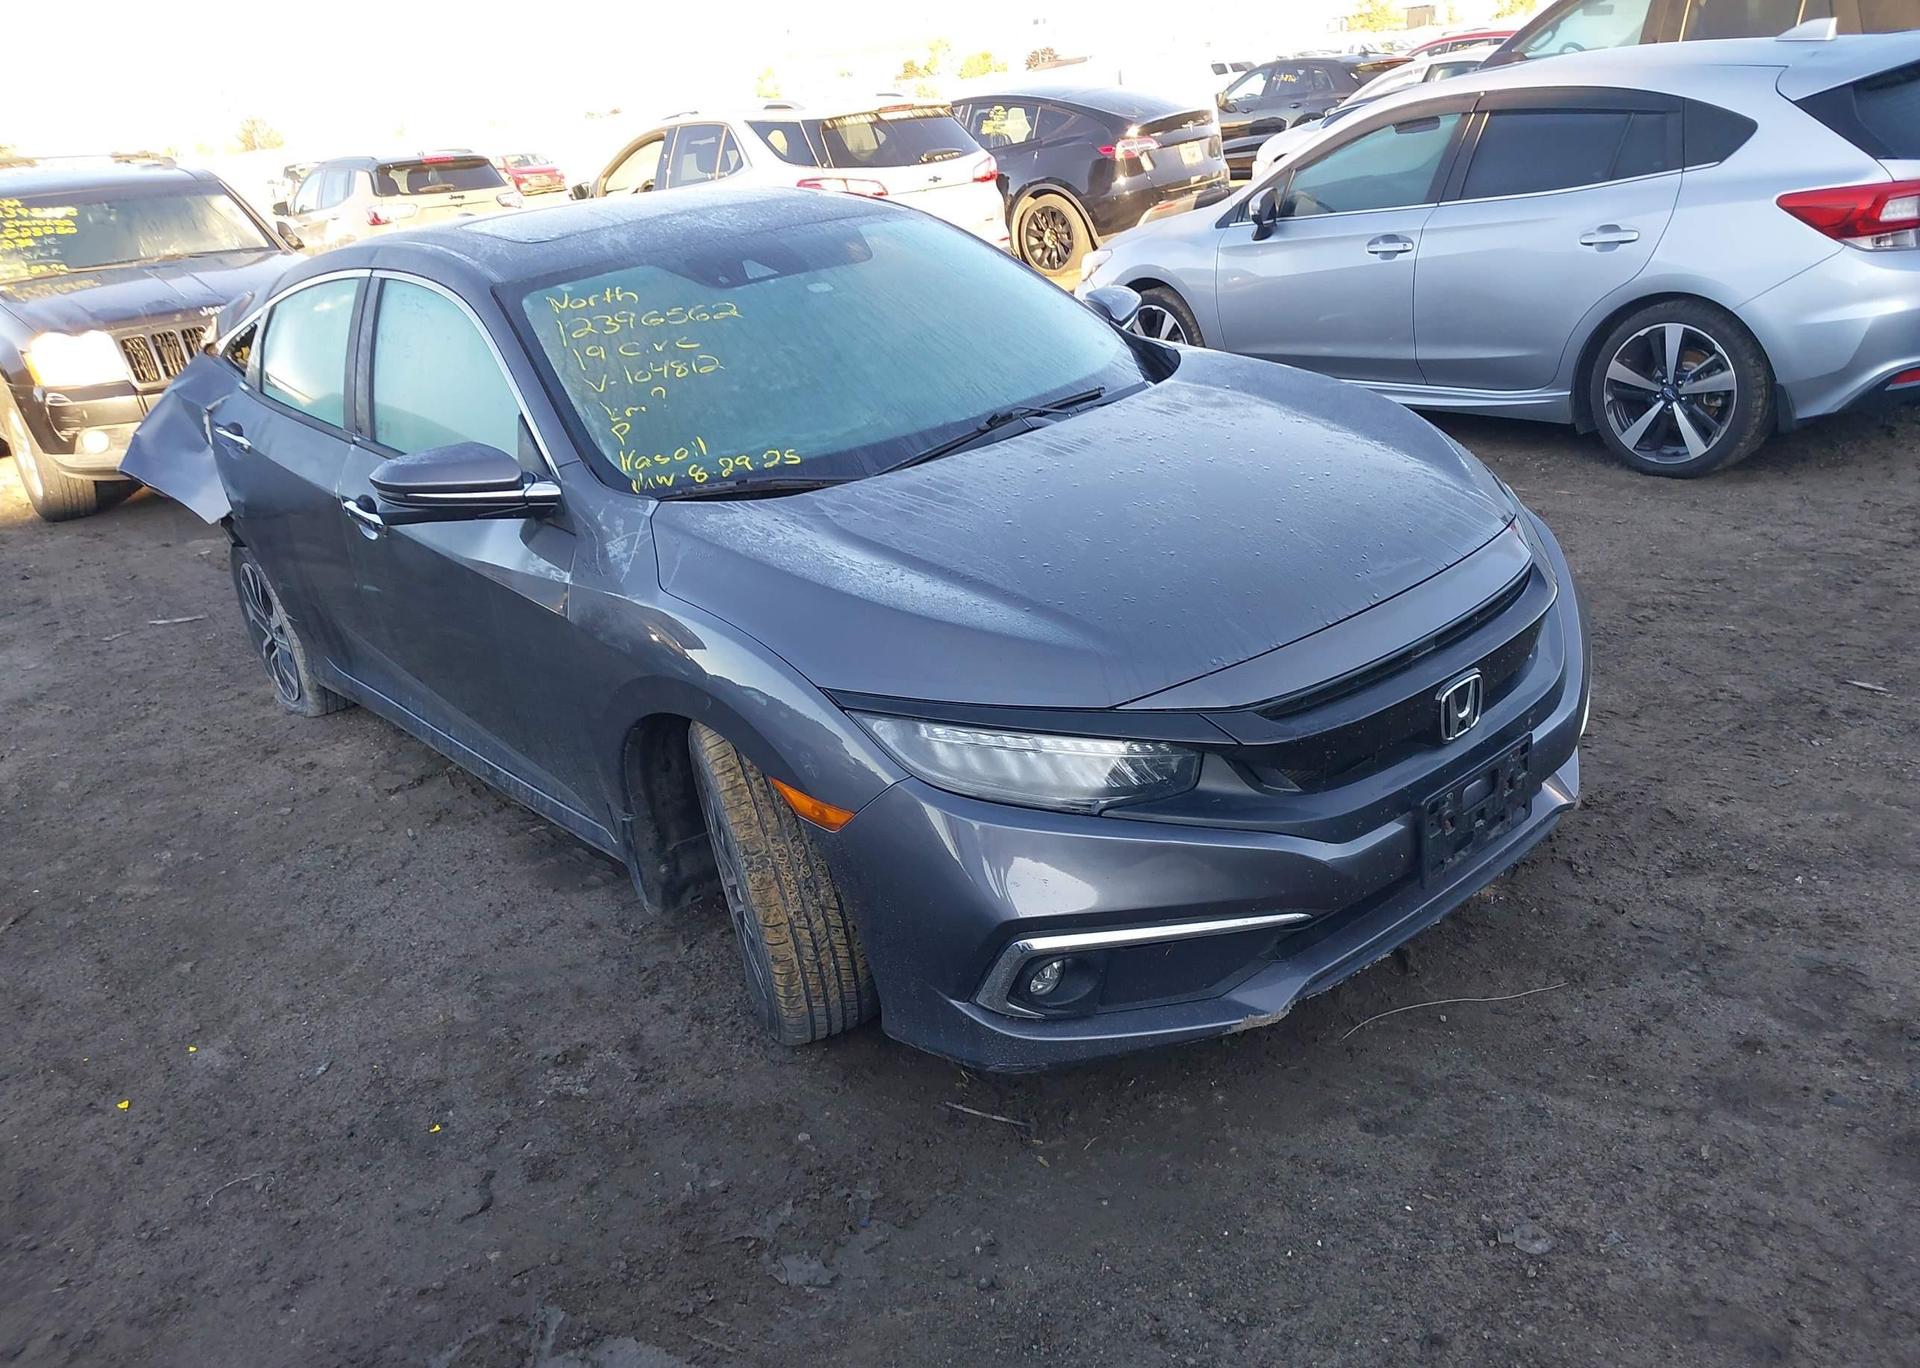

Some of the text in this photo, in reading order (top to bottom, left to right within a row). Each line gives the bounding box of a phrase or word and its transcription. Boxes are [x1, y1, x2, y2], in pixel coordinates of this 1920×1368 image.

[545, 286, 639, 314] North
[556, 302, 744, 347] 12396562
[610, 422, 631, 446] P
